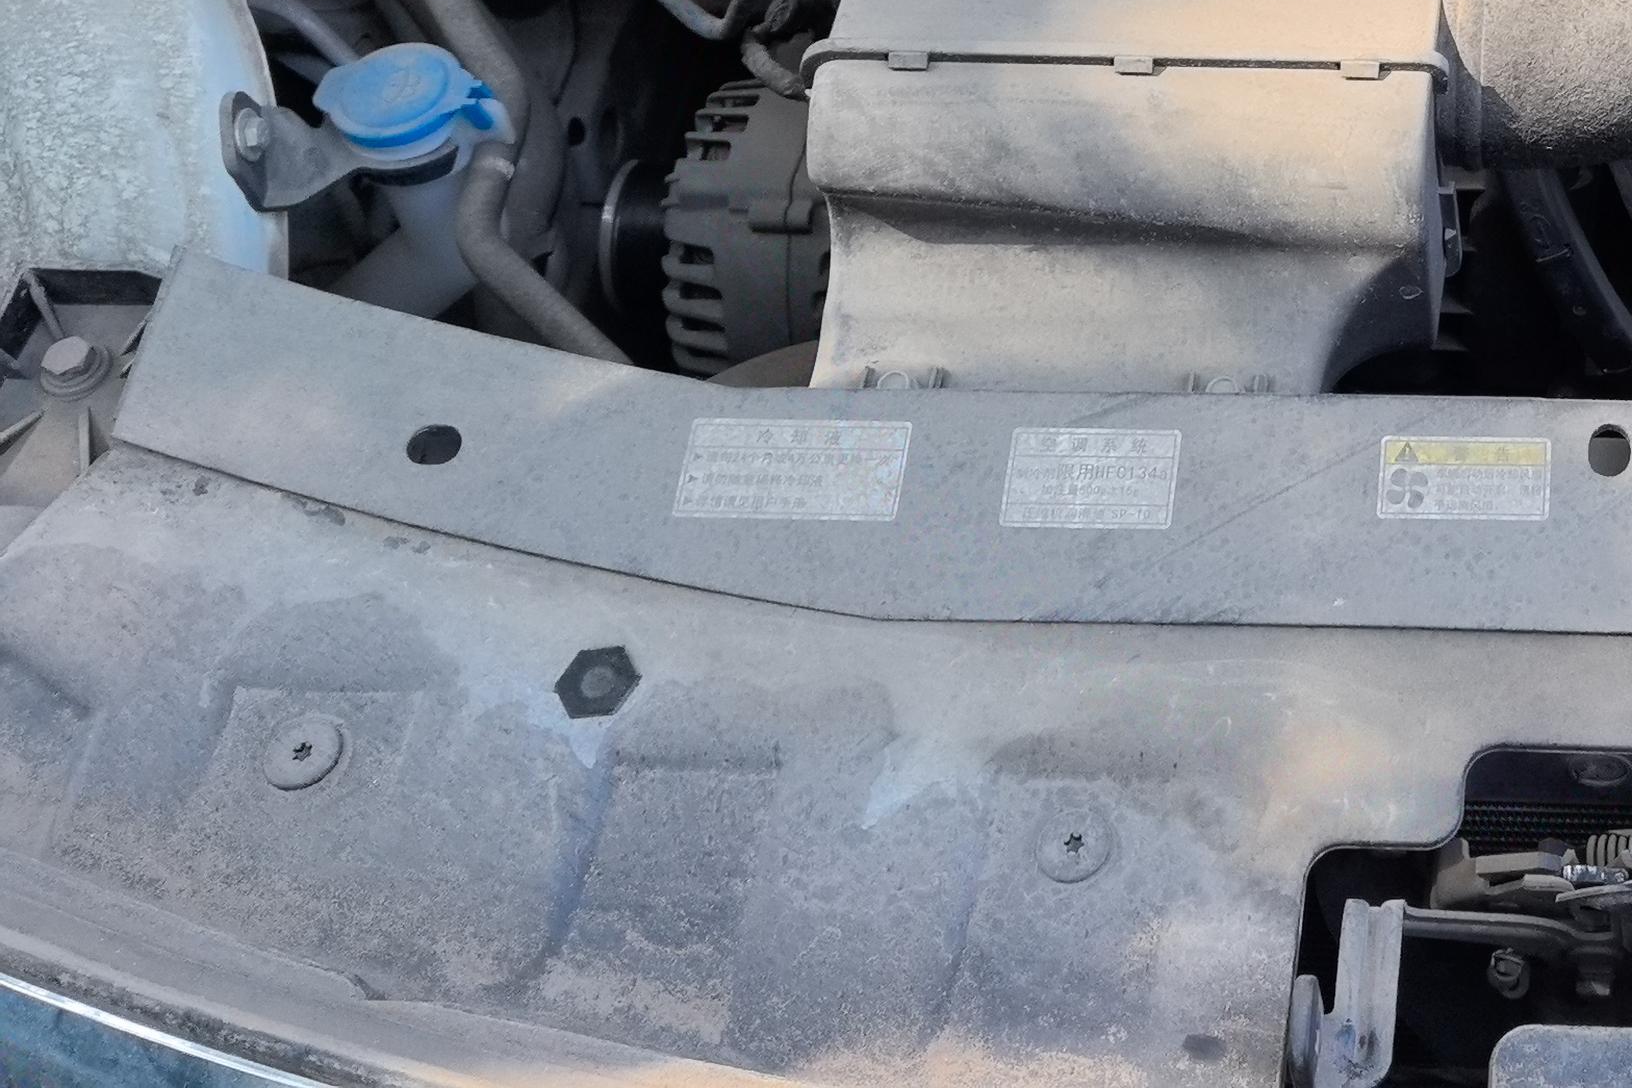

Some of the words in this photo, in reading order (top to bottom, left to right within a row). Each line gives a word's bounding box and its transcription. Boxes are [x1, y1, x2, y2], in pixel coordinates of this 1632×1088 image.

[756, 427, 843, 445] 冷却液
[1039, 436, 1148, 455] 空调系统
